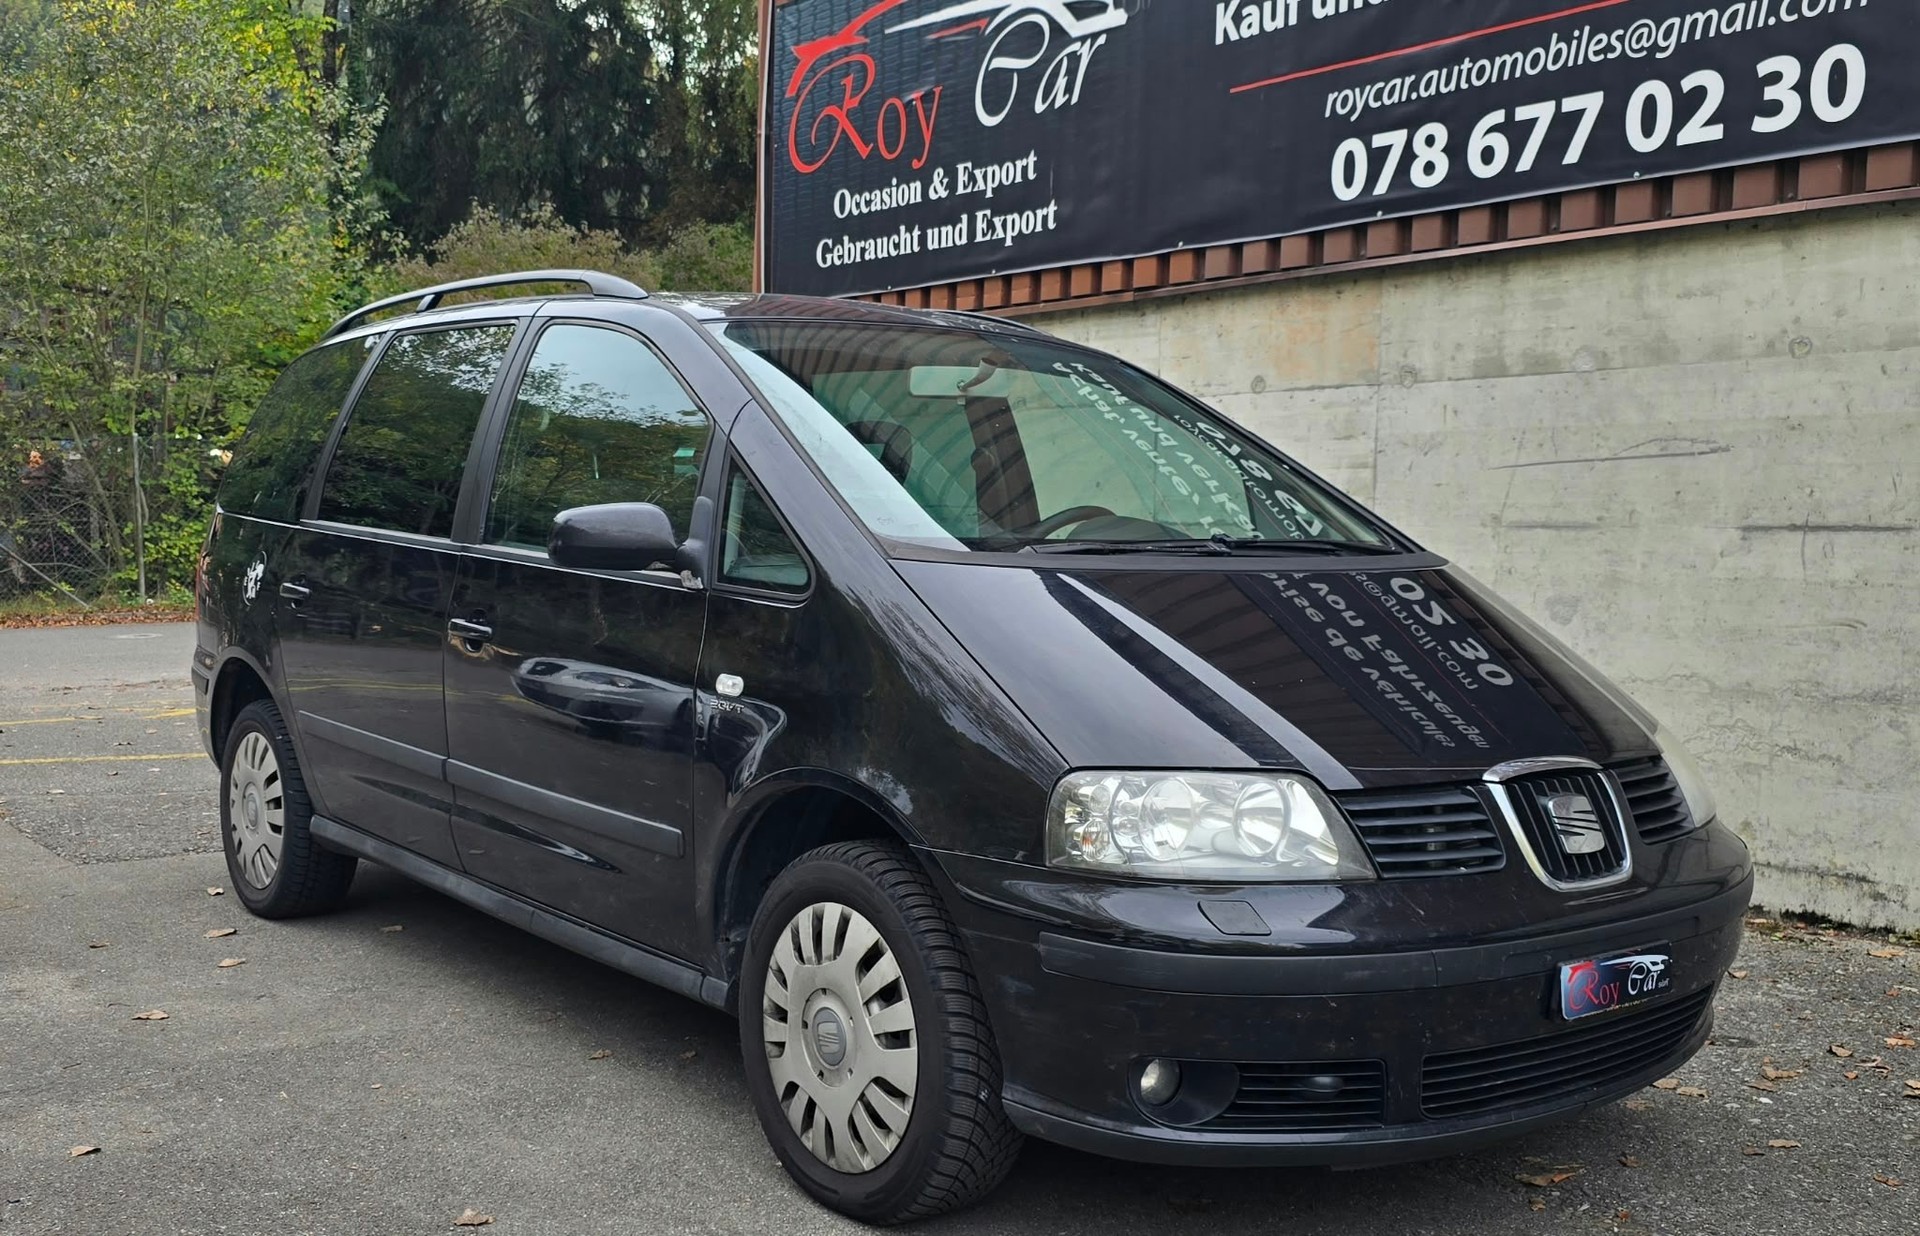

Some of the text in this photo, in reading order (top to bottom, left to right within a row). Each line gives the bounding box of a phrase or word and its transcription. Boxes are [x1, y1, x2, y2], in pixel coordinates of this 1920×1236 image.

[1215, 0, 1300, 46] Kauf
[788, 13, 1107, 174] Roy Car
[1330, 43, 1867, 202] 078 677 02 30
[833, 149, 1037, 219] Occasion & Export
[815, 199, 1058, 269] Gebraucht und Export
[1569, 968, 1620, 1012] Roy
[1628, 962, 1661, 996] Car
